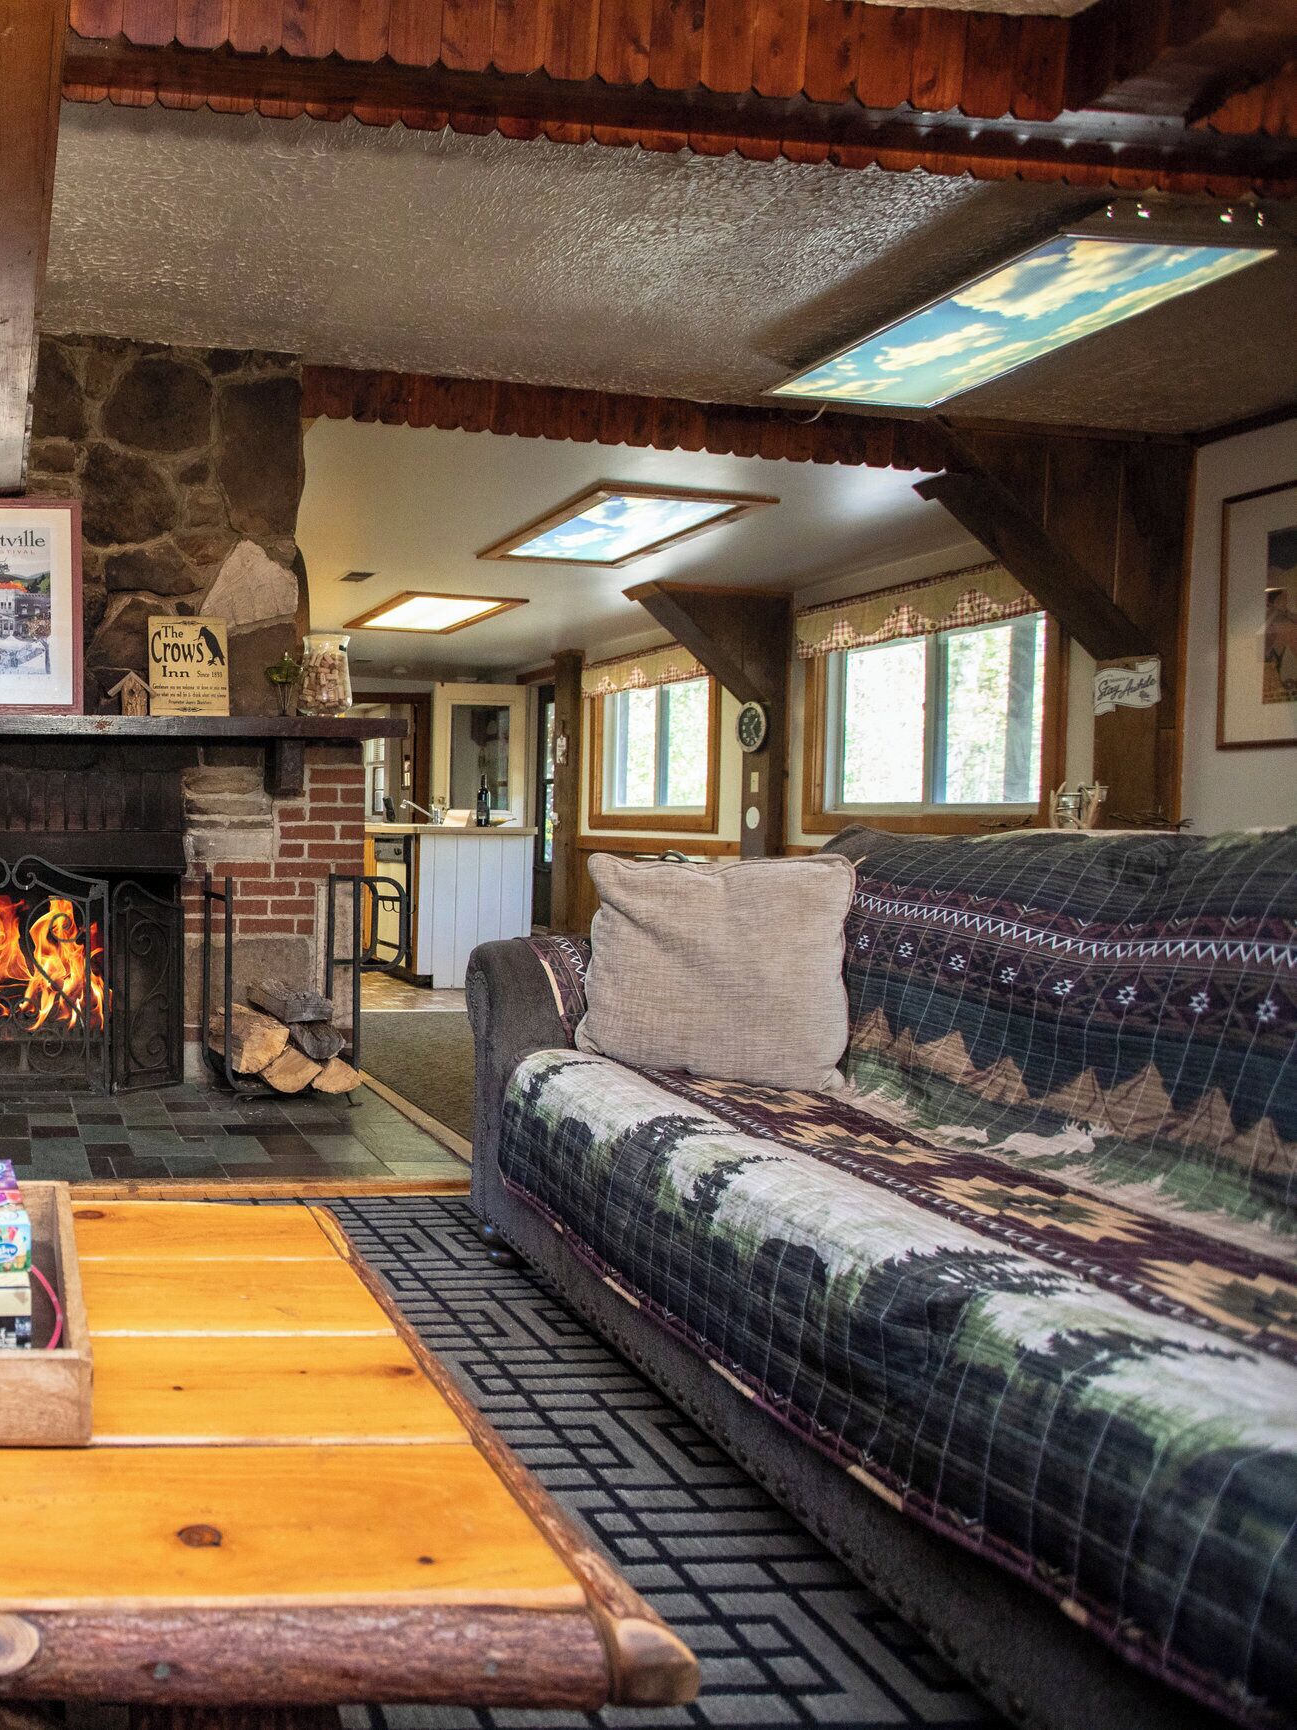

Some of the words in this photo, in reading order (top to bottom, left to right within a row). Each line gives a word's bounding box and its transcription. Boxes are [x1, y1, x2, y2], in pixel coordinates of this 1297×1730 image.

[161, 625, 184, 638] The
[151, 630, 204, 663] Crows
[161, 665, 190, 678] Inn
[196, 670, 209, 678] Since
[1097, 680, 1120, 701] Stay
